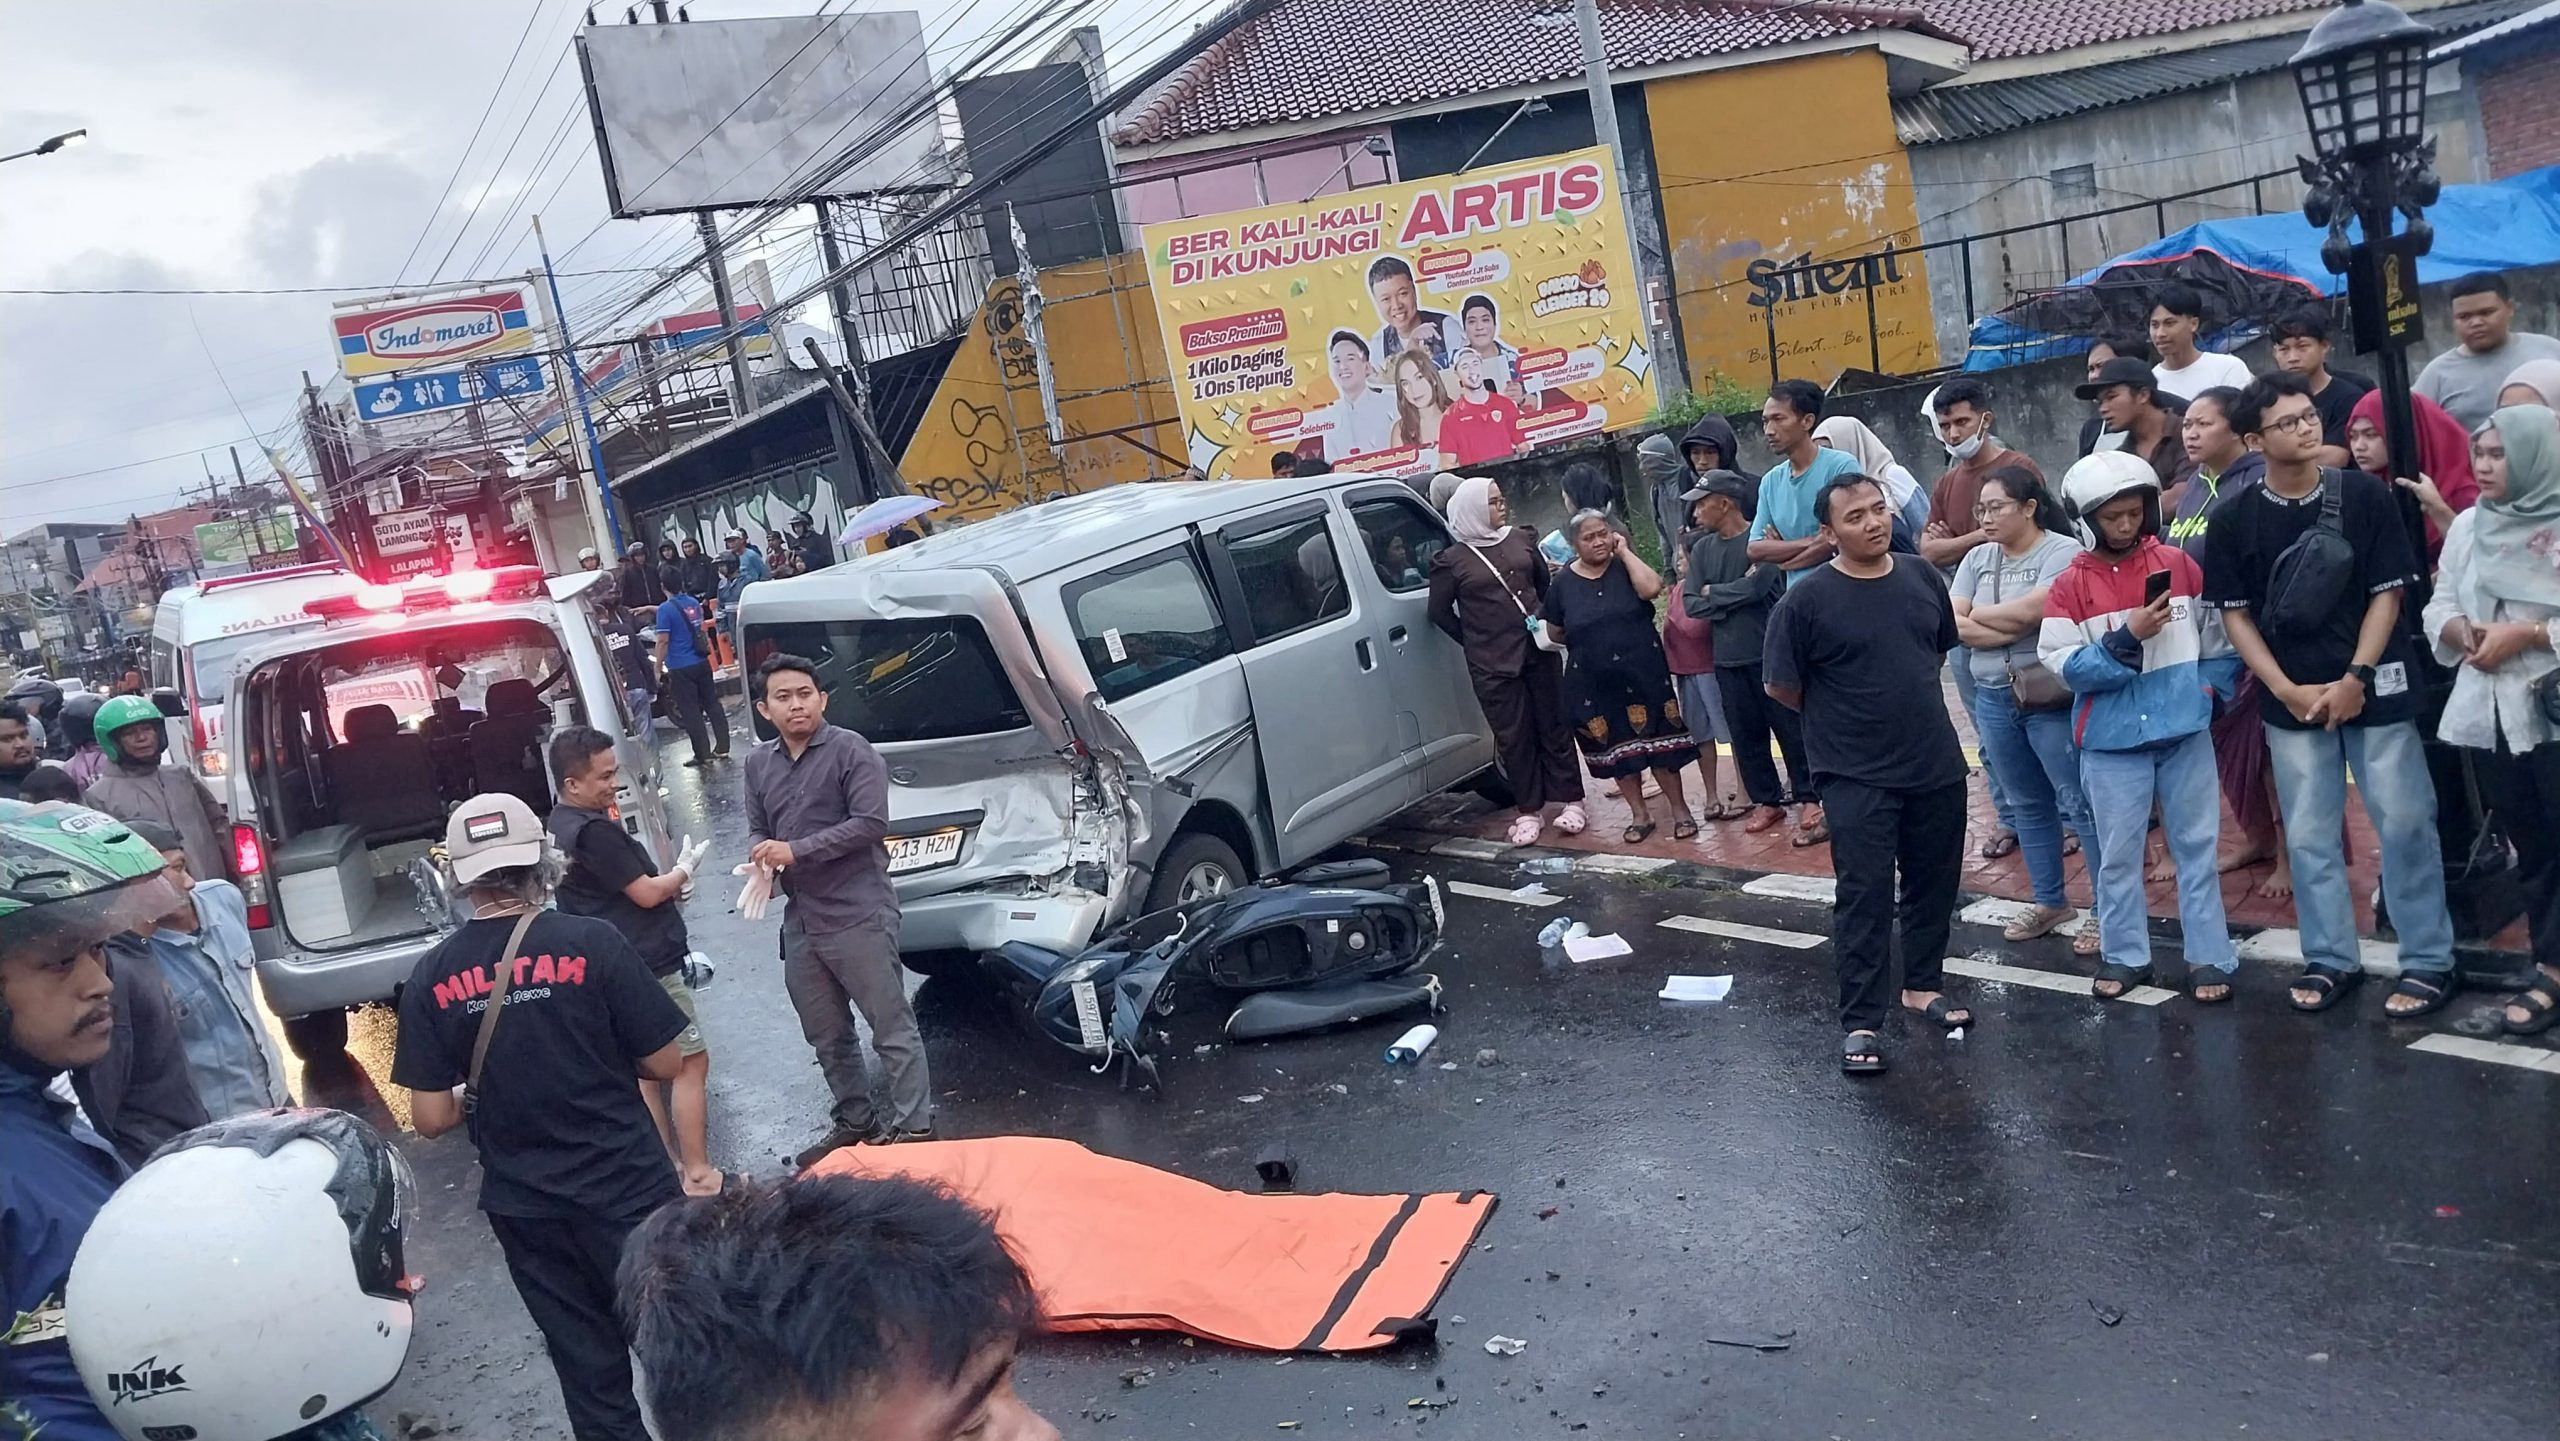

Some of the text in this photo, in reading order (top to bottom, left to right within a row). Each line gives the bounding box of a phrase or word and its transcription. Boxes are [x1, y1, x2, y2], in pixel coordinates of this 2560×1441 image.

[1401, 165, 1599, 243] ARTIS
[1169, 229, 1229, 257] BER
[1241, 216, 1305, 245] KALI
[1172, 228, 1380, 285] DI KUNJUNGI
[1445, 268, 1473, 280] Youtuber
[1484, 263, 1500, 273] Subs
[1470, 274, 1494, 285] Creator
[1746, 241, 1904, 307] Silent
[1810, 284, 1909, 311] FURNIURE
[376, 313, 497, 350] Indomaret
[1188, 321, 1282, 349] Bakso Premium
[1187, 347, 1285, 380] 1 Kilo Daging
[1194, 366, 1294, 400] 1 Ons Tepung
[1299, 420, 1335, 436] Selebritis
[1395, 463, 1432, 478] Selebritis
[375, 518, 431, 536] SOTO AYAM
[390, 556, 435, 574] LALAPAN
[126, 708, 151, 719] Grab
[889, 834, 957, 859] 613 HZM
[107, 1362, 188, 1394] INK
